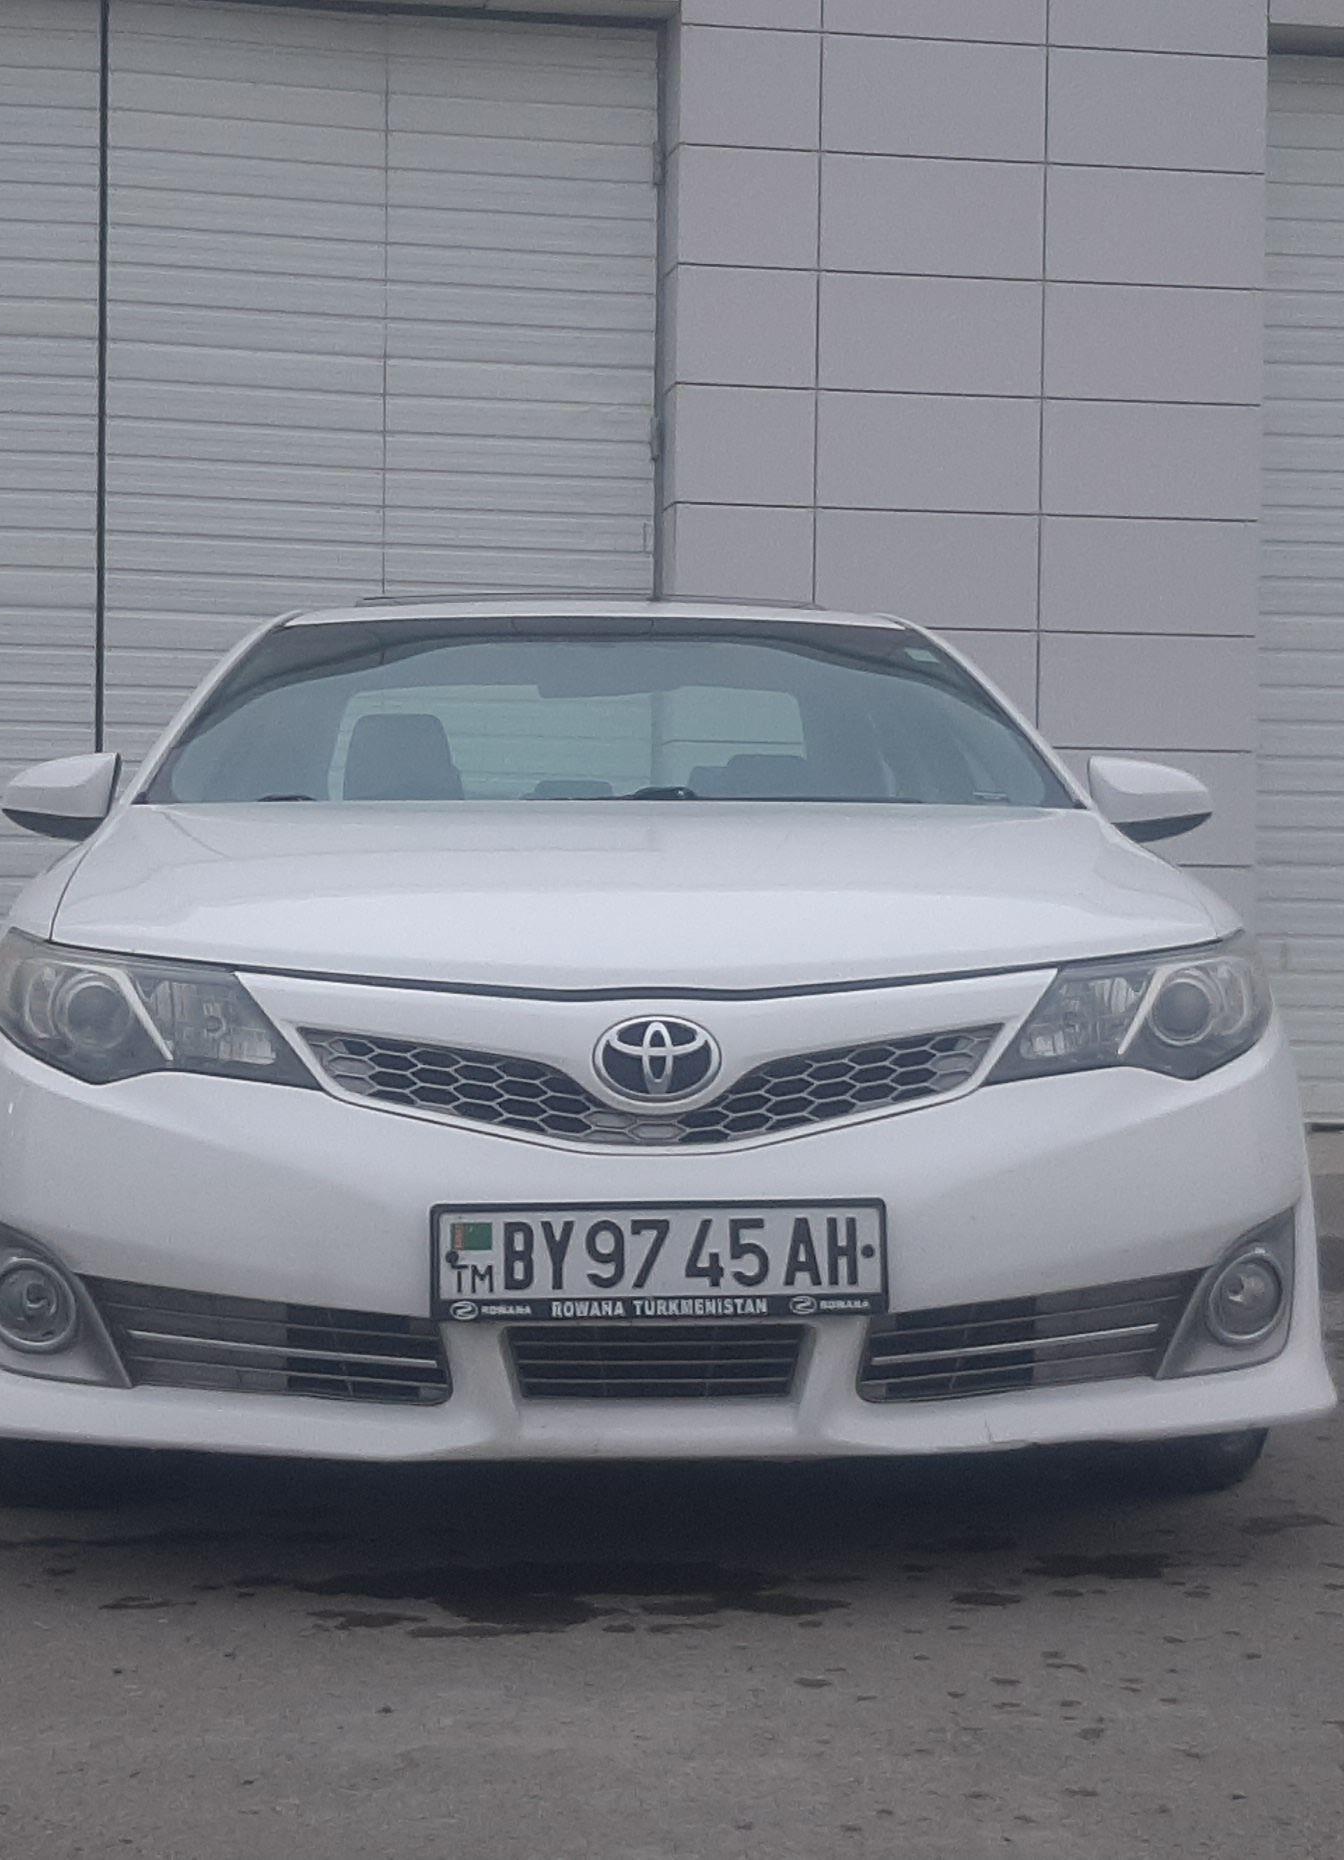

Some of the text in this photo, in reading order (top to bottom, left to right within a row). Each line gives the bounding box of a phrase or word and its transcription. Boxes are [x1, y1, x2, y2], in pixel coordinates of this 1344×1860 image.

[685, 1217, 770, 1287] 45
[784, 1216, 858, 1286] AH
[451, 1264, 494, 1293] TM
